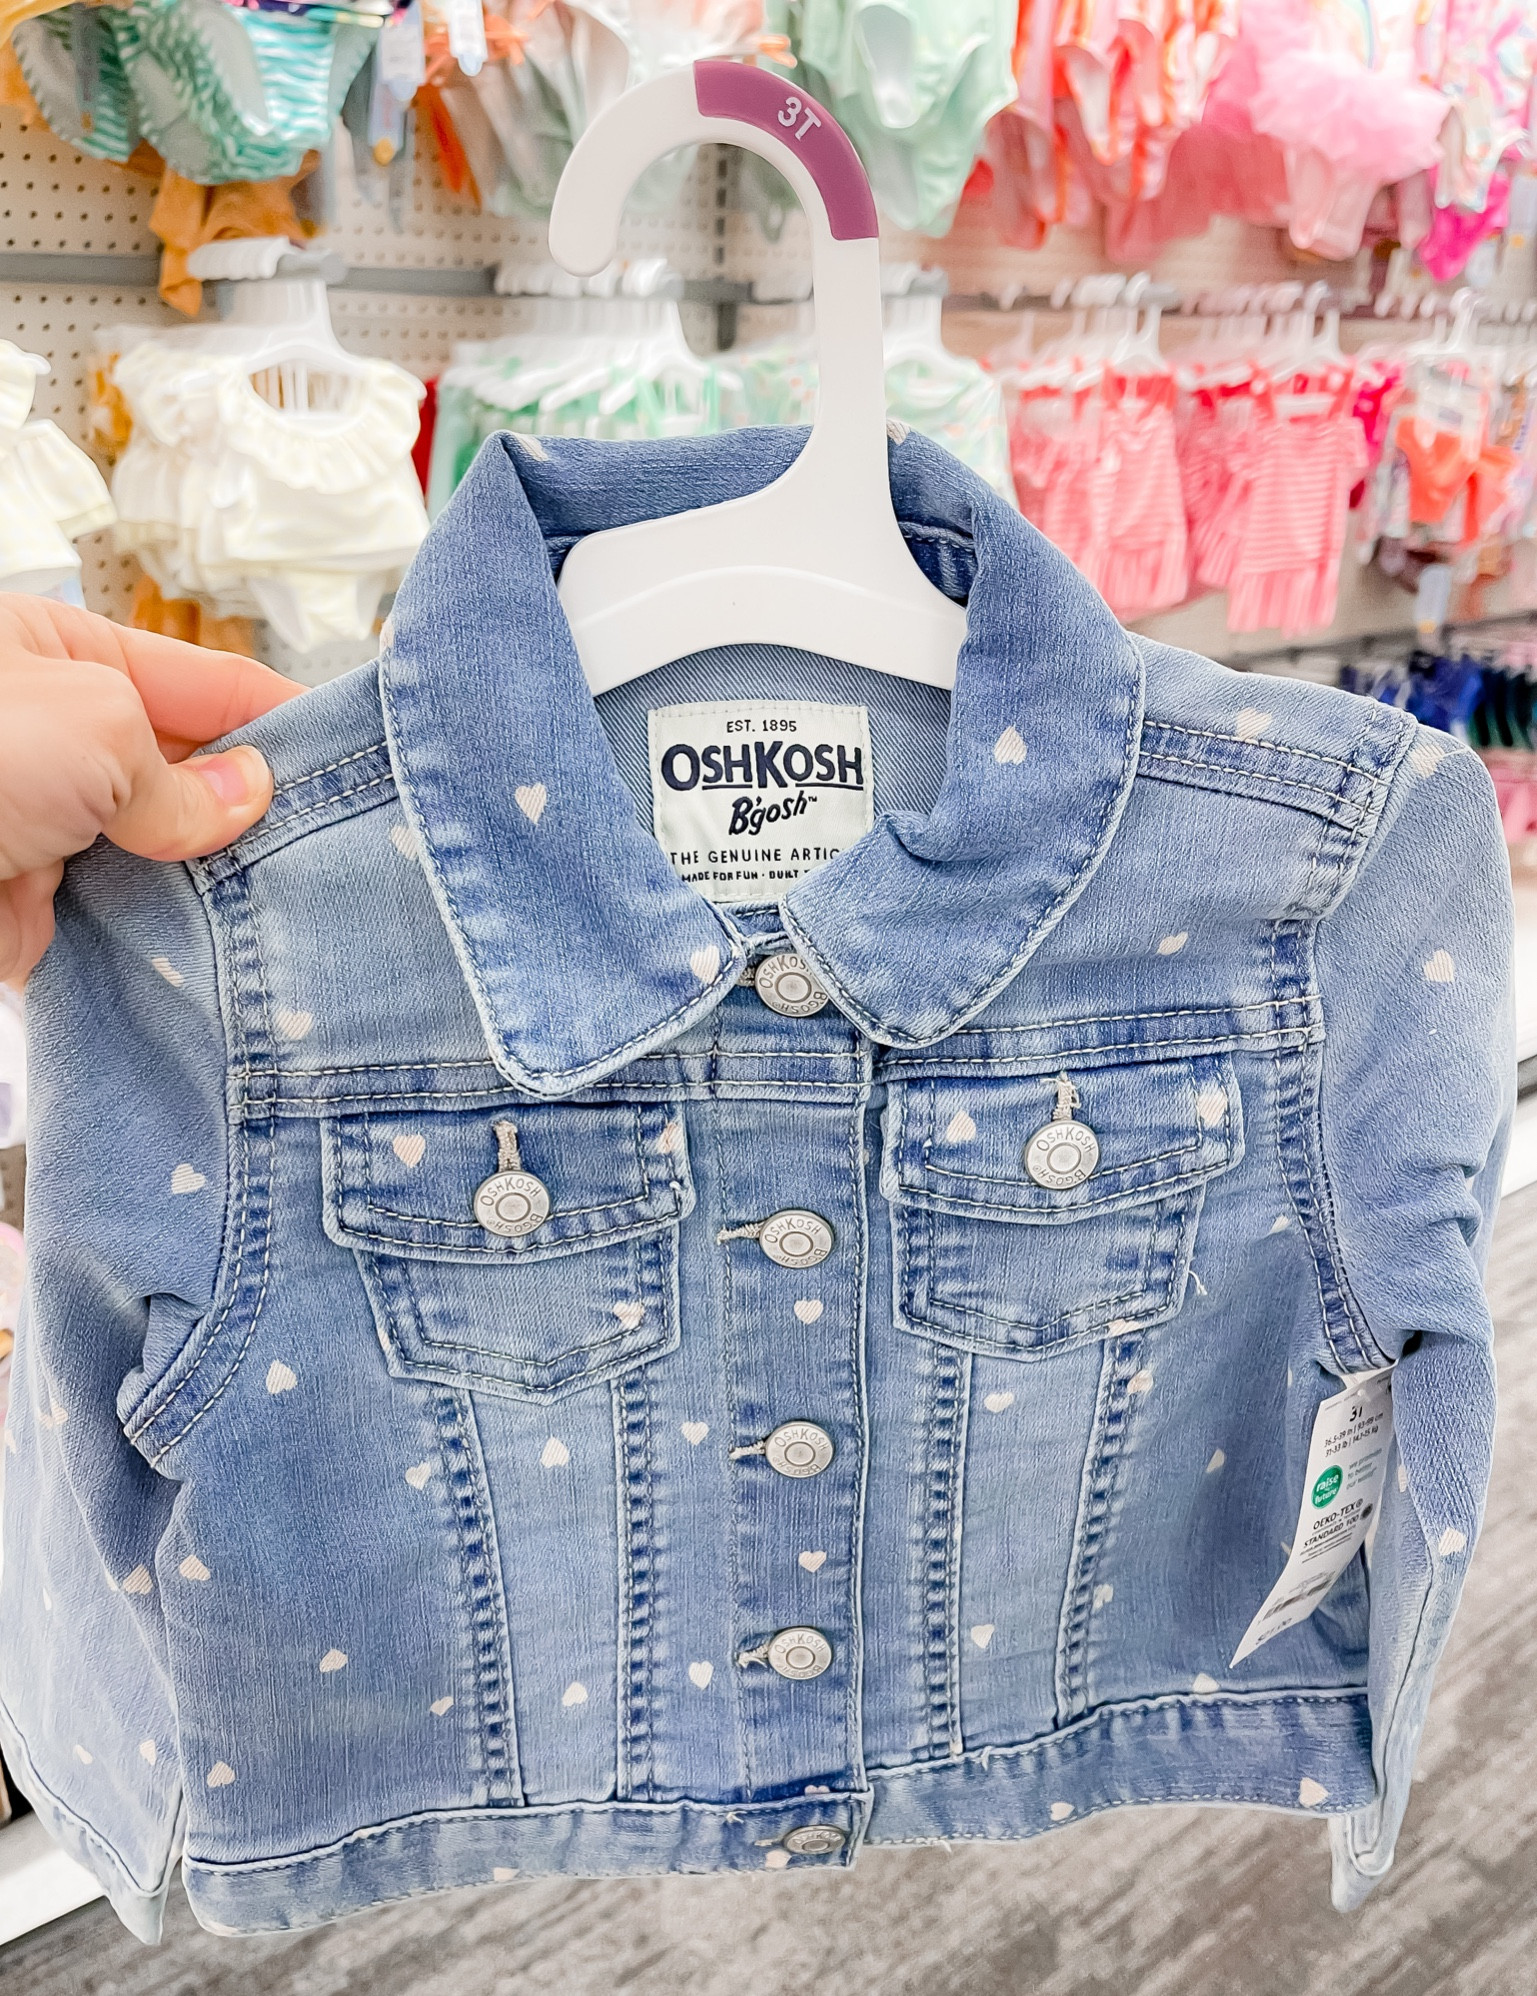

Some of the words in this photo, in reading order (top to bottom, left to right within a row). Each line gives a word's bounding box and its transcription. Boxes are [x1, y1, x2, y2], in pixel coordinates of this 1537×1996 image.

[777, 96, 822, 141] 3T
[726, 719, 756, 733] EST.
[762, 719, 798, 732] 1895
[661, 741, 864, 791] OSHKOSH
[670, 851, 699, 865] THE
[708, 848, 781, 863] GENUINE
[791, 847, 843, 861] ARTIC
[681, 871, 709, 882] MADE
[713, 871, 733, 881] FOR
[736, 870, 758, 880] FUN
[758, 955, 813, 988] OSHKOS
[1036, 1126, 1096, 1153] OSHKOSH
[480, 1177, 541, 1206] OSHKOSH
[1316, 1474, 1339, 1492] raise
